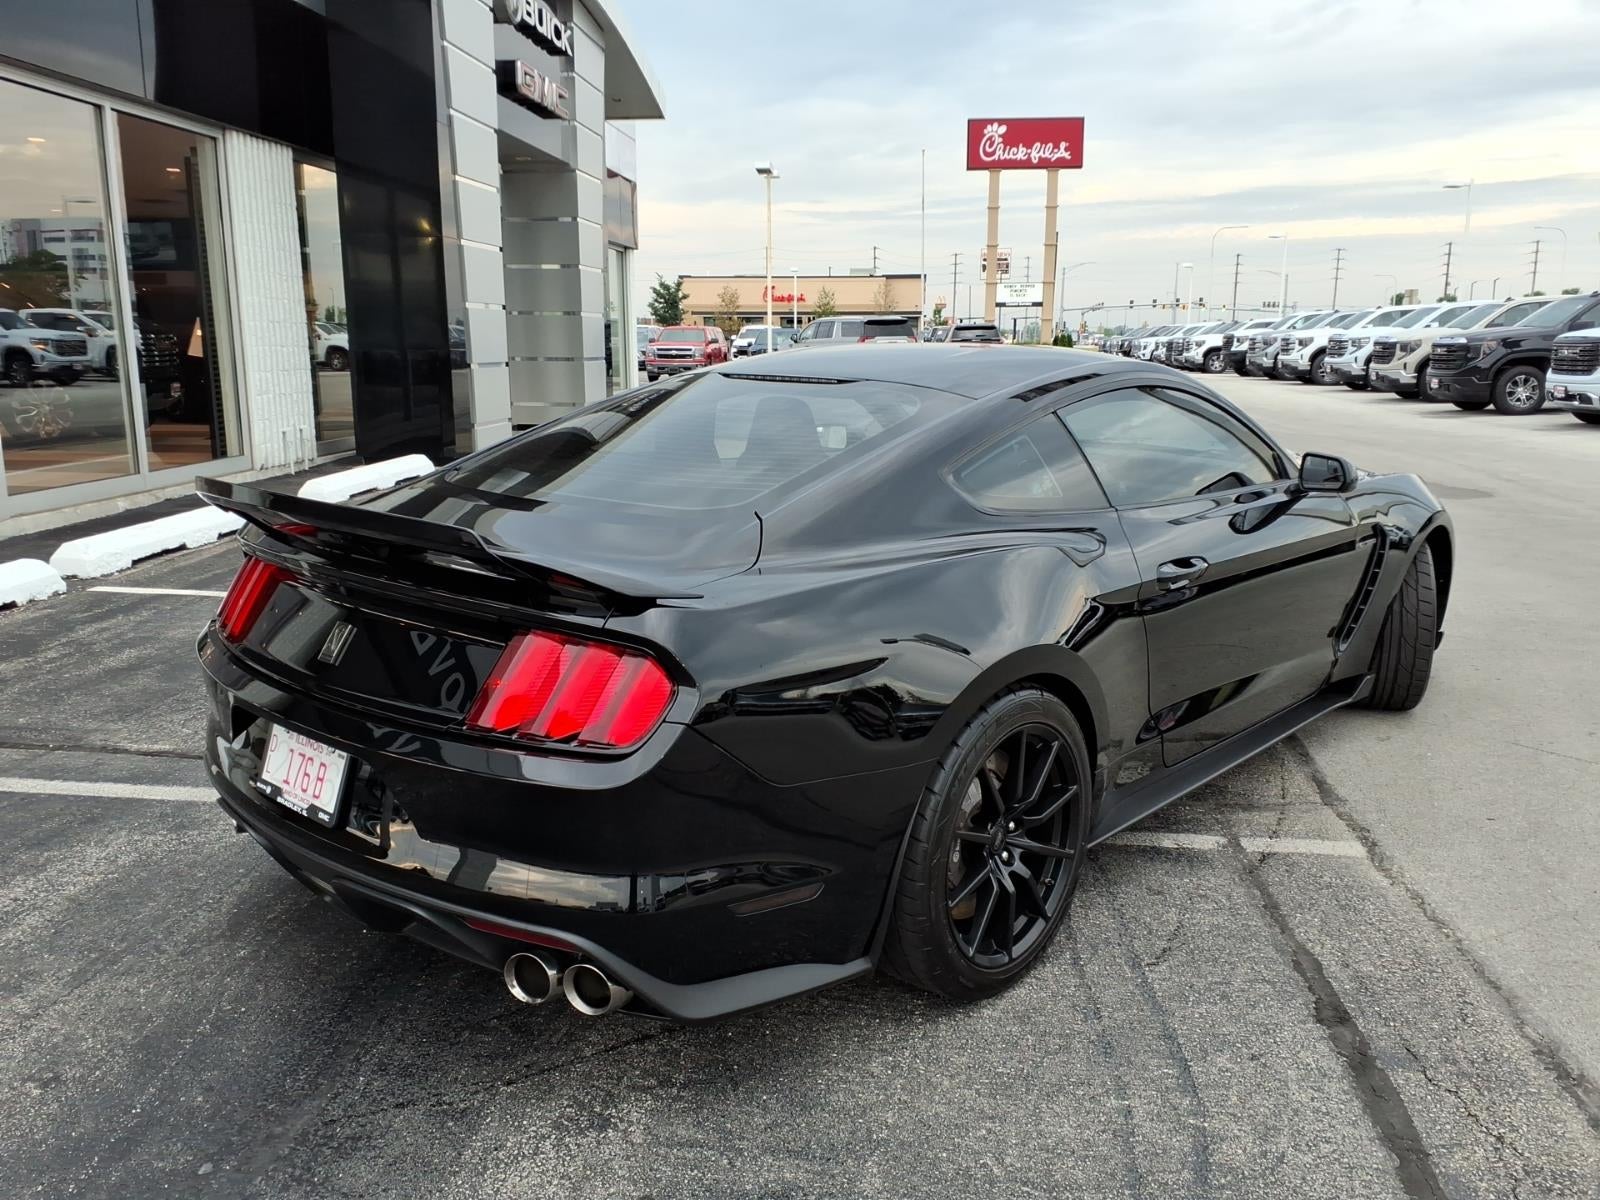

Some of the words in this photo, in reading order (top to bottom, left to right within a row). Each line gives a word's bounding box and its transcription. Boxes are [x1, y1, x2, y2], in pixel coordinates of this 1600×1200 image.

[523, 0, 573, 56] BUICK
[516, 60, 569, 119] GMC
[979, 122, 1072, 164] Chick-fil-A
[295, 733, 325, 754] ILLINOIS
[282, 748, 314, 793] 176
